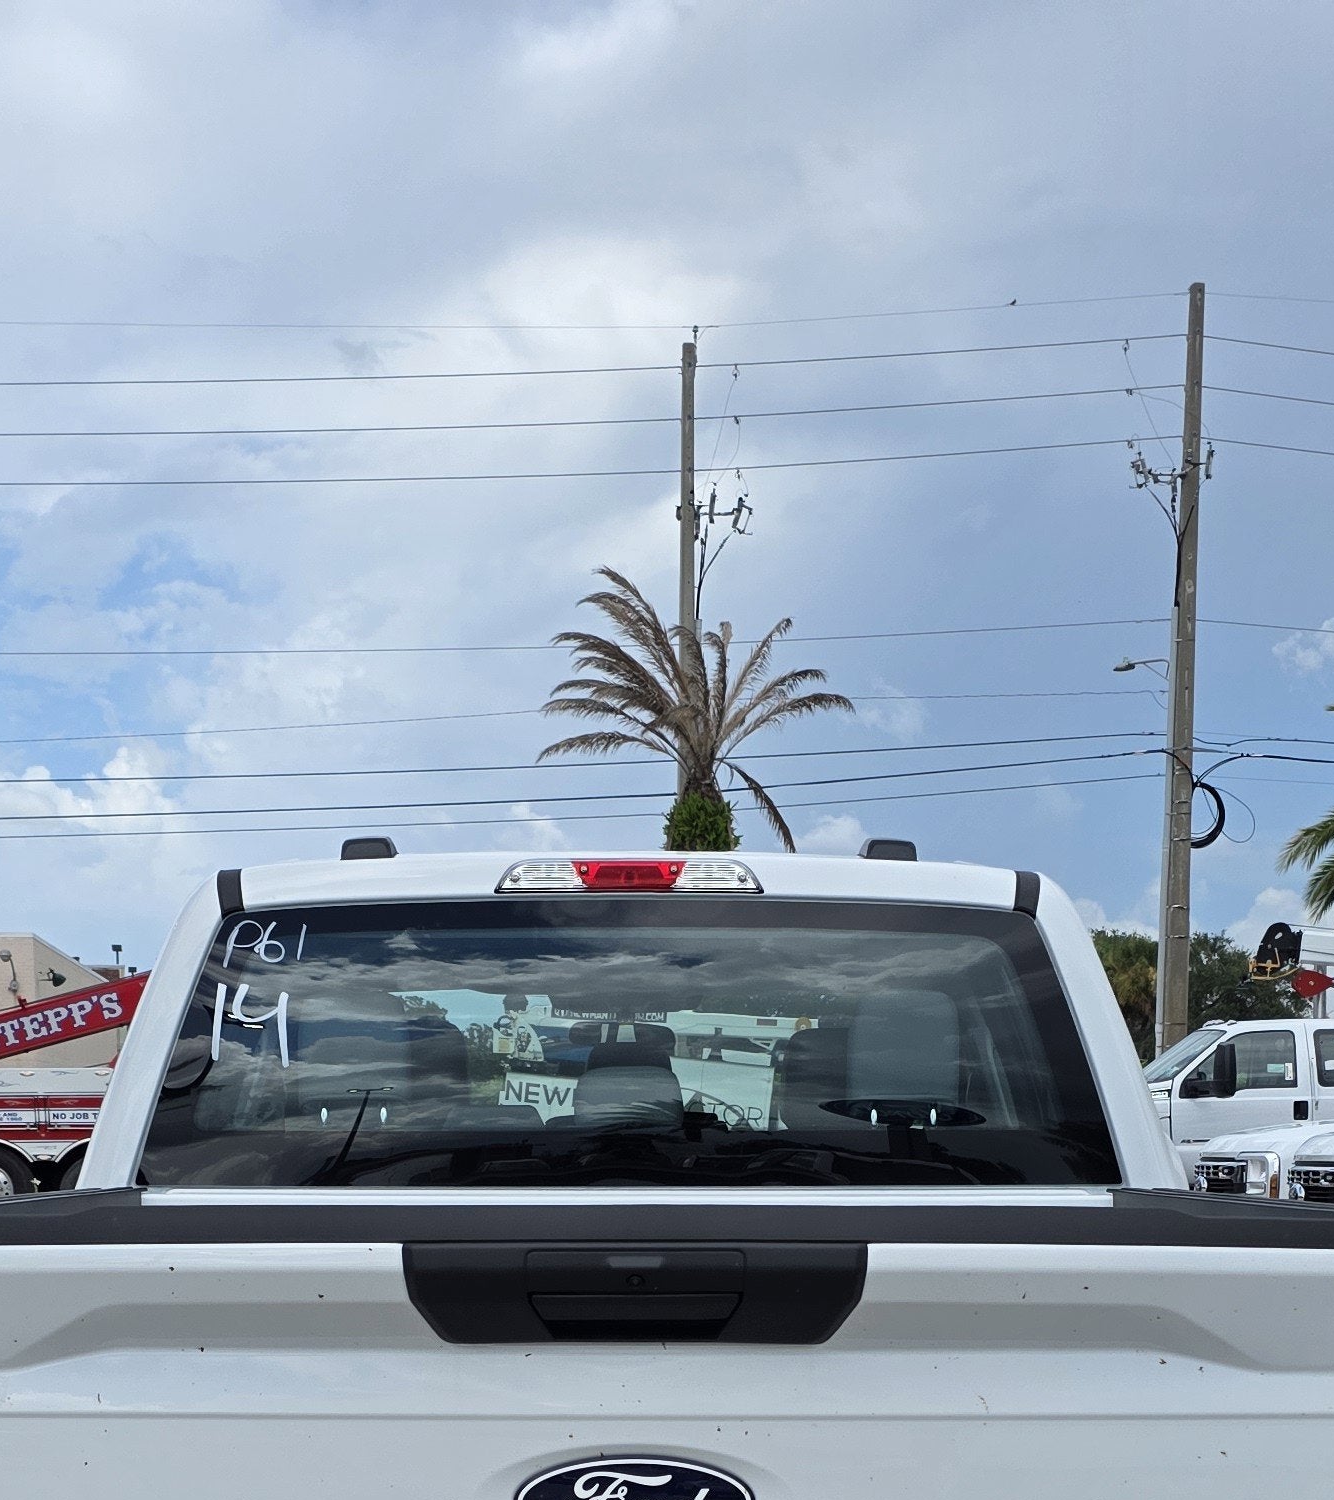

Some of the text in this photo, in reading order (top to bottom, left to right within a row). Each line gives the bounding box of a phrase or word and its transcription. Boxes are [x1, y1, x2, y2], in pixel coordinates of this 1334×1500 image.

[211, 982, 290, 1069] 14
[52, 1112, 67, 1120] NO
[69, 1112, 90, 1120] JOB
